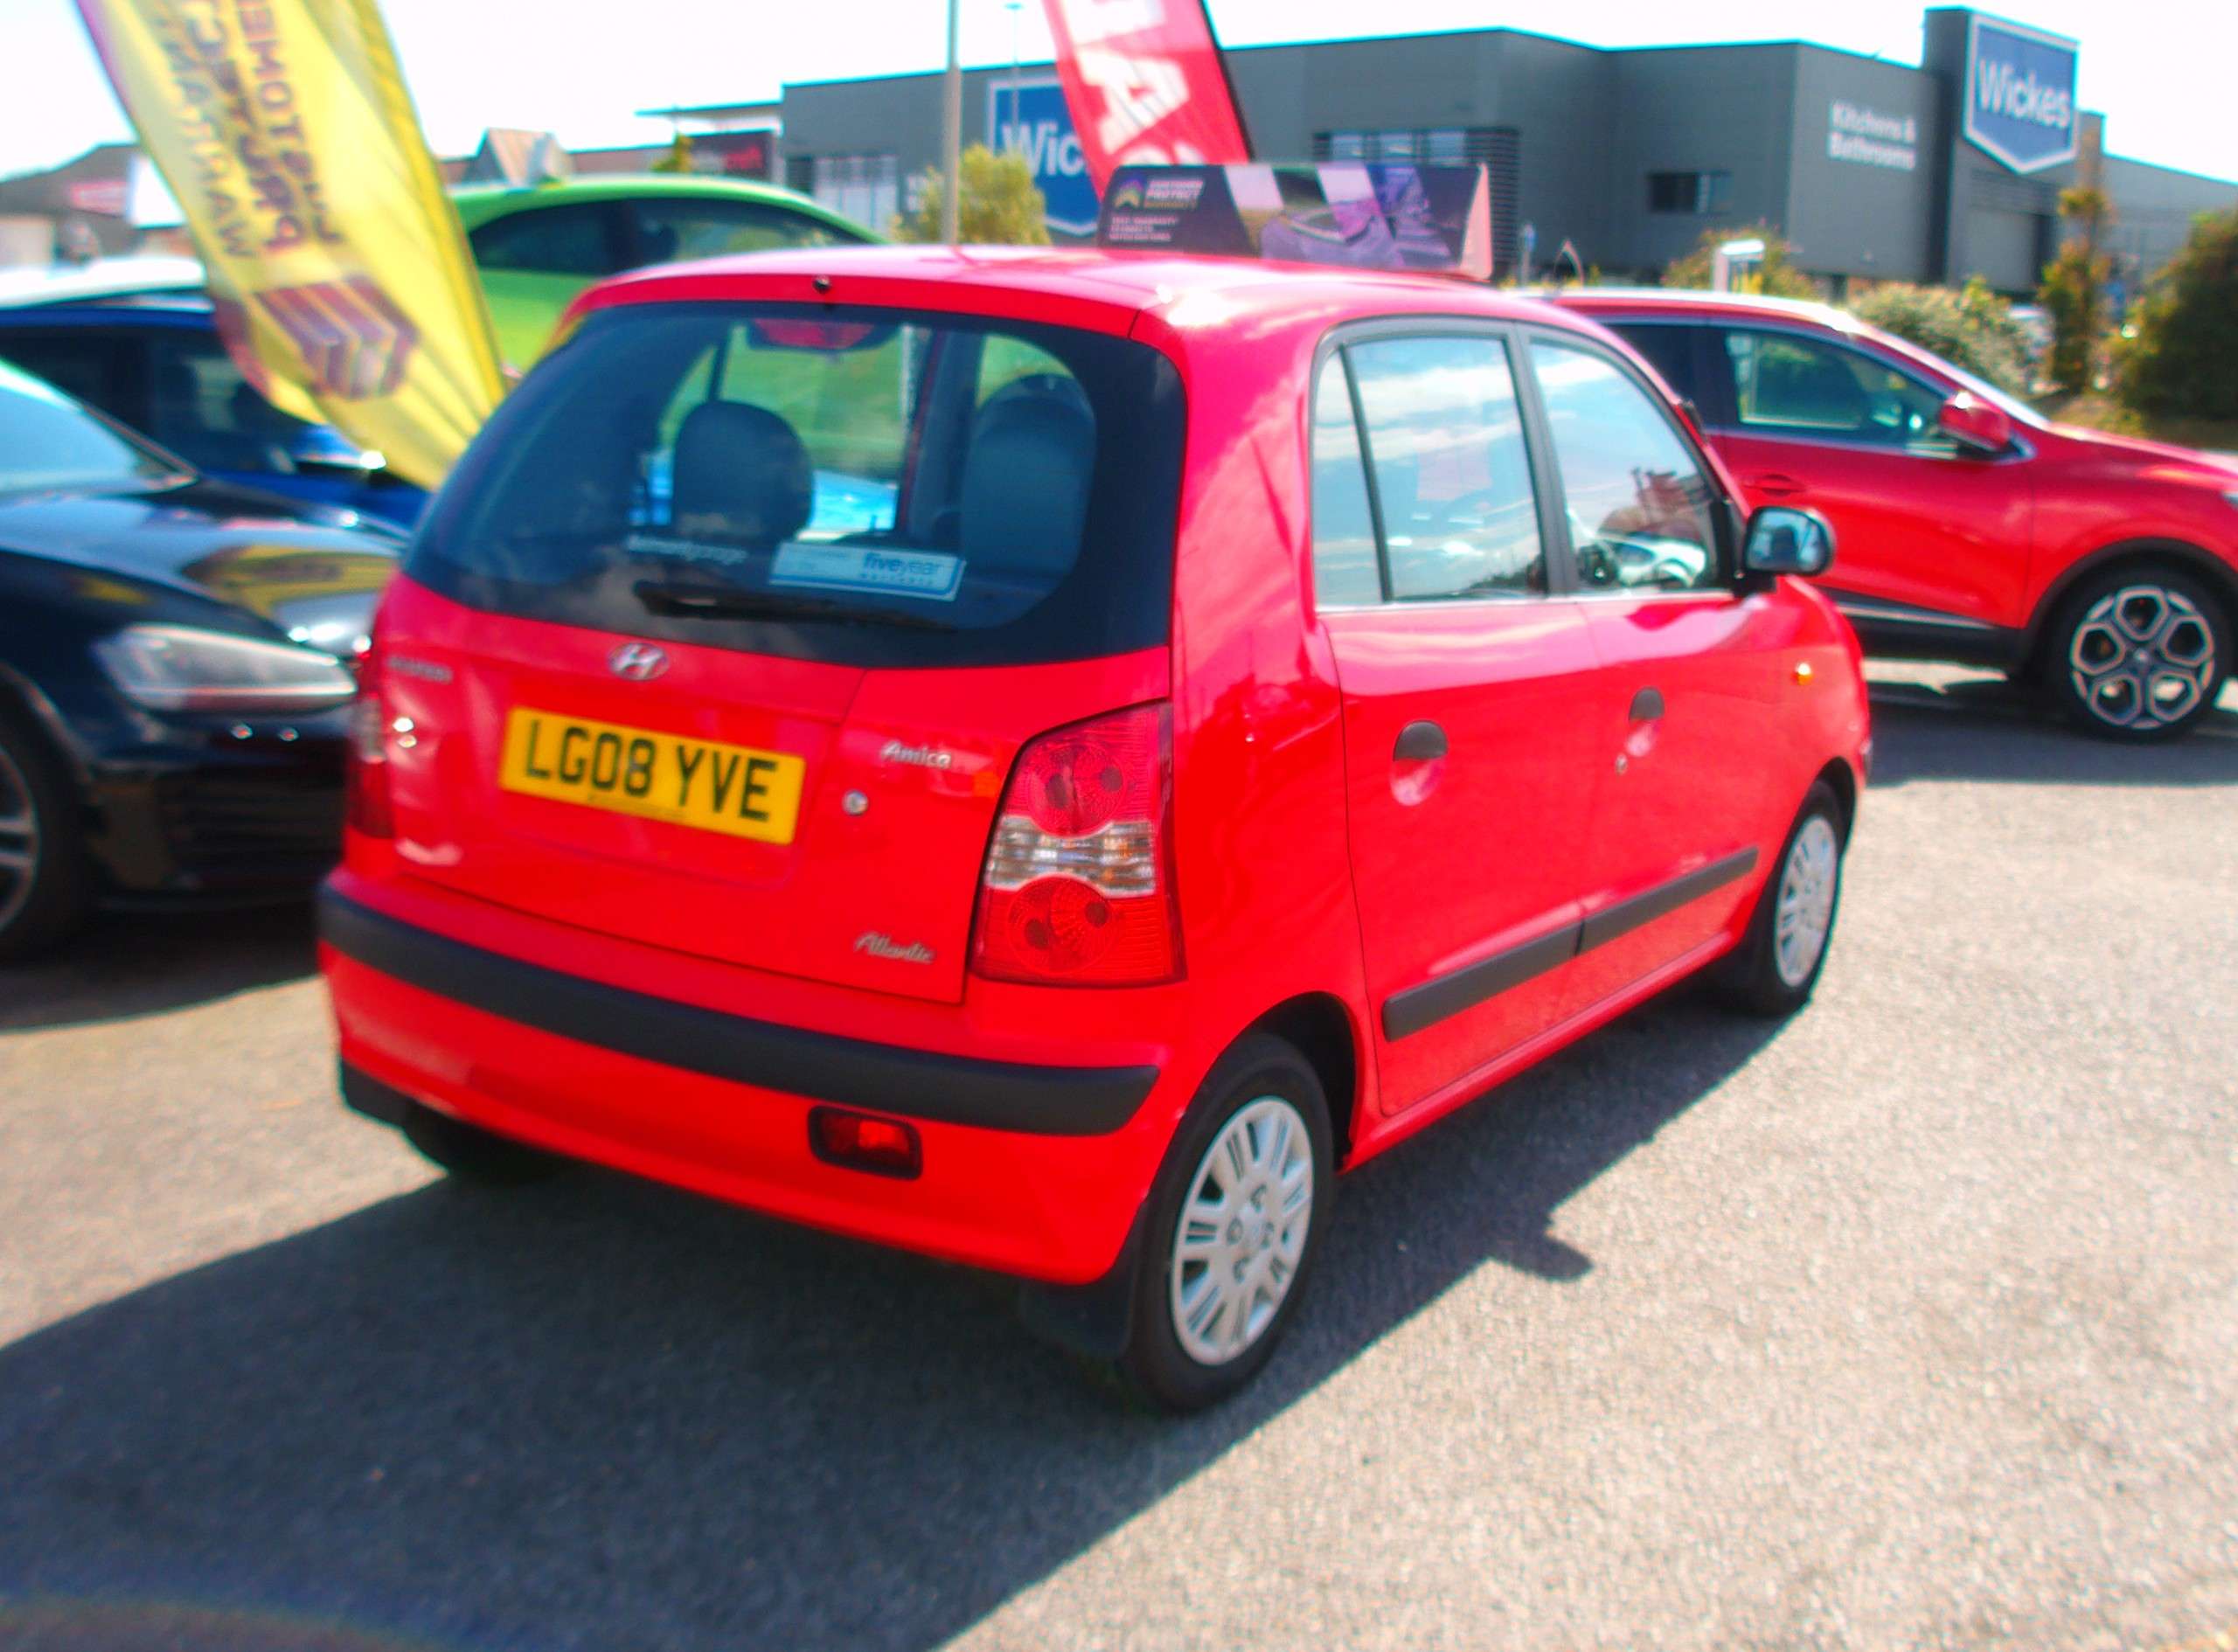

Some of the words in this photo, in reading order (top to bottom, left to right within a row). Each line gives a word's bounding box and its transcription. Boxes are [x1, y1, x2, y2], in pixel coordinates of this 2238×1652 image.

[1832, 101, 1902, 142] Kitchens
[1979, 59, 2071, 129] Wickes
[526, 718, 657, 798] LG08
[676, 745, 778, 823] YVE
[881, 739, 952, 770] Amica
